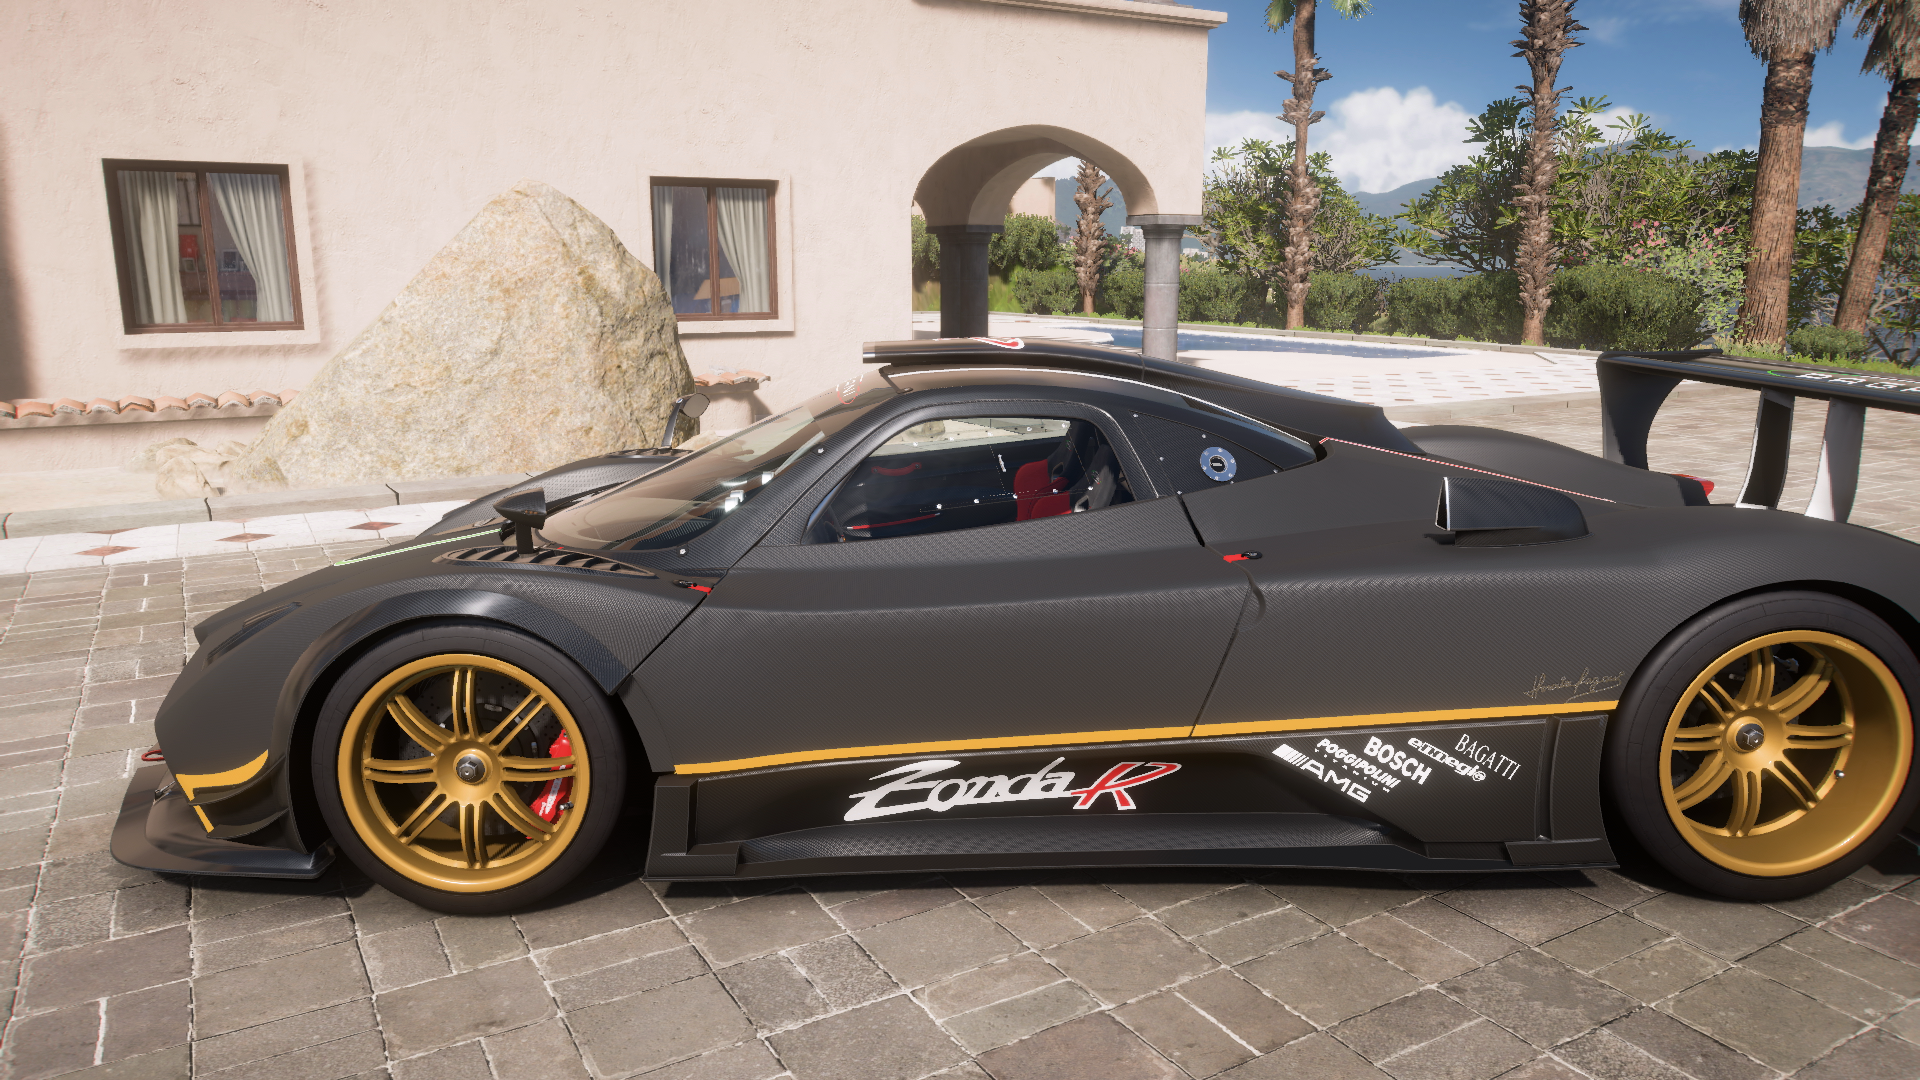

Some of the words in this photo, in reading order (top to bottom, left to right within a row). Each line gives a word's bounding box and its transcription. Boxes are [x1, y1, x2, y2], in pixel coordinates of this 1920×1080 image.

[1300, 759, 1372, 804] AMG
[1316, 738, 1401, 789] POGGIPOLINI
[1363, 735, 1433, 786] BOSCH
[1455, 733, 1522, 781] BAGATTI
[843, 756, 1075, 822] Zonda
[1070, 761, 1182, 811] R
